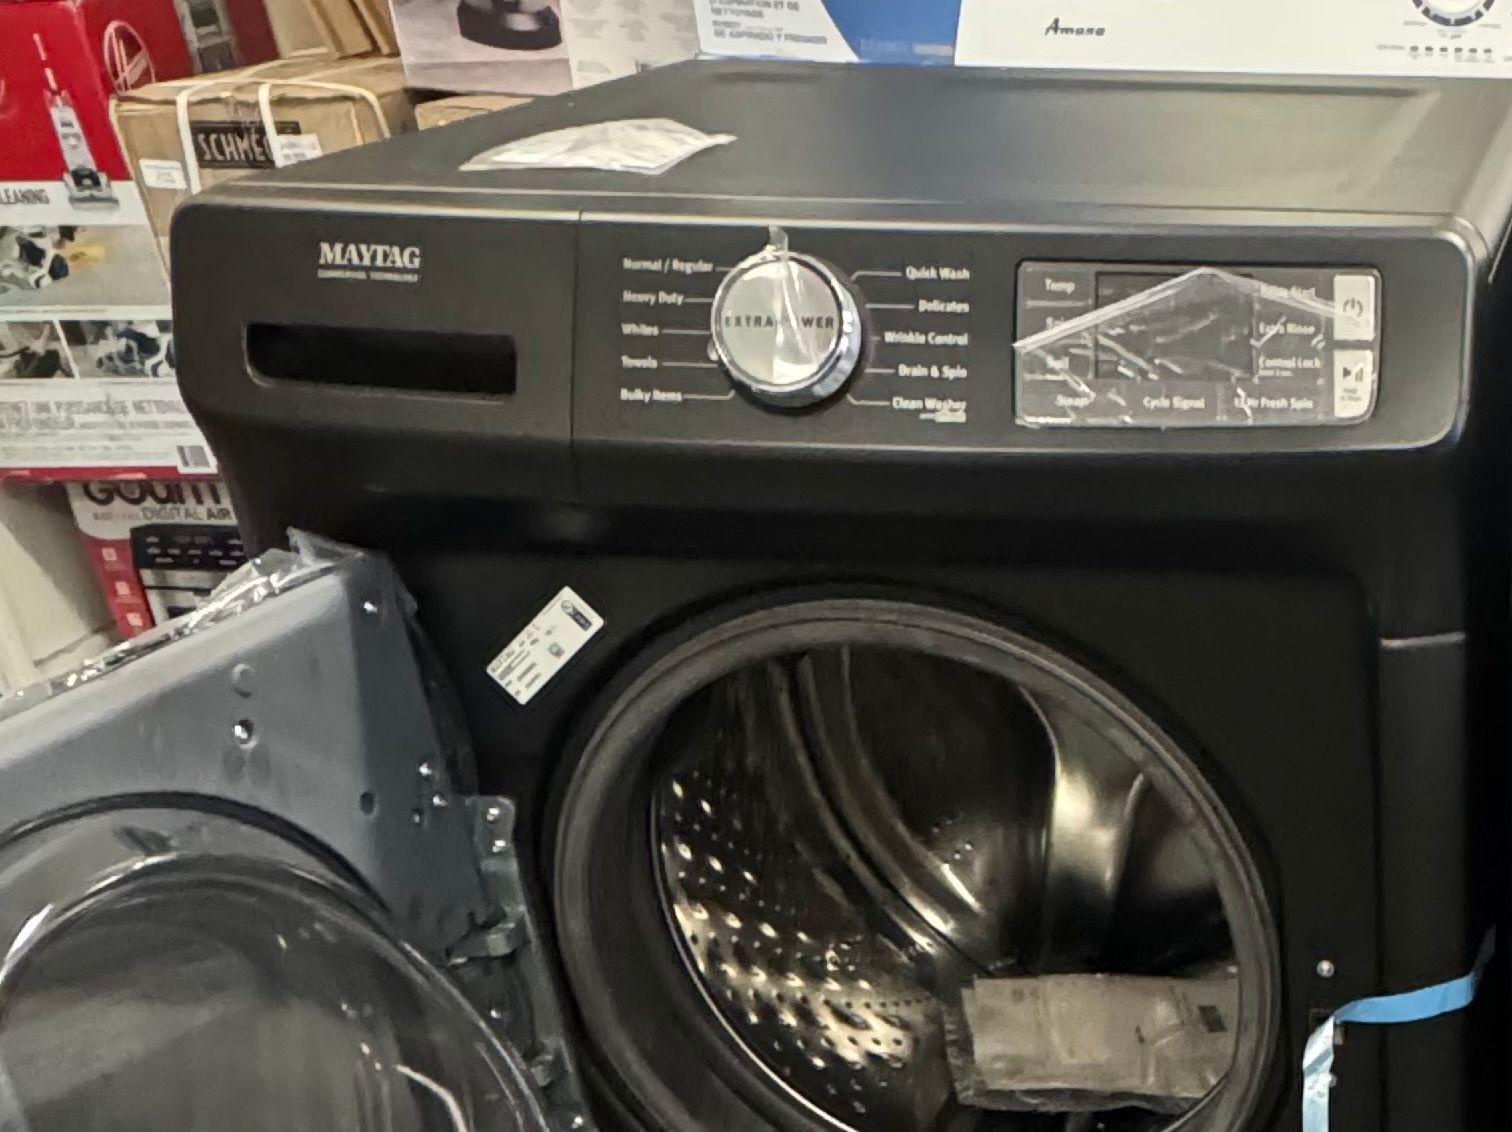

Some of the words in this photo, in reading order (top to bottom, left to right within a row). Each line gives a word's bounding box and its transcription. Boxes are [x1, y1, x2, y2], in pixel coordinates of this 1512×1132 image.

[1044, 17, 1106, 36] Amana
[319, 241, 421, 269] MAYTAG
[623, 257, 662, 271] Normal
[672, 258, 714, 274] Regular
[905, 266, 937, 281] Quick
[939, 266, 970, 281] Wash
[622, 289, 656, 305] Heavy
[918, 299, 970, 313] Delicates
[724, 314, 774, 329] EXTRA
[927, 331, 968, 345] Control
[898, 363, 928, 377] Drain
[1142, 395, 1170, 410] Cycle
[1171, 395, 1206, 411] Signal
